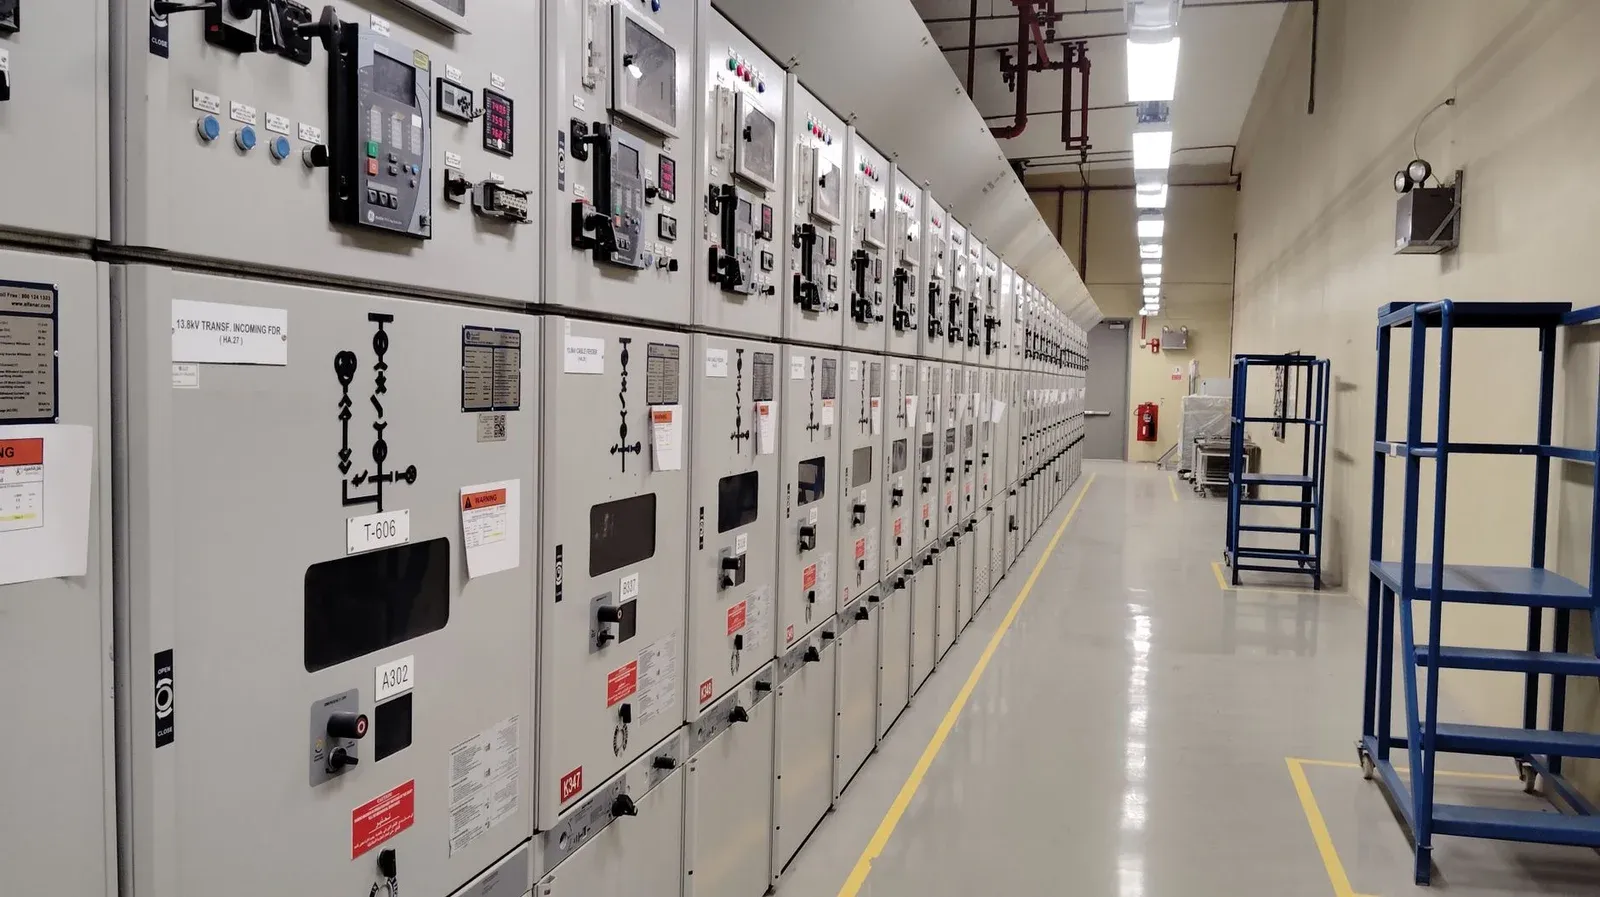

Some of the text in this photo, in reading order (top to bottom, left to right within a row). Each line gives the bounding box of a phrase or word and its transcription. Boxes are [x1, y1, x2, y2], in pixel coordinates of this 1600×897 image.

[151, 36, 168, 48] CLOSE
[176, 319, 281, 335] 13.8kV TRANSF. INCOMING FDR
[474, 493, 498, 504] WARNING
[364, 519, 396, 541] T-606
[623, 578, 637, 595] B337
[157, 666, 171, 675] OPEN
[382, 664, 408, 690] A302
[157, 726, 173, 737] CLOSE
[563, 771, 581, 799] K347
